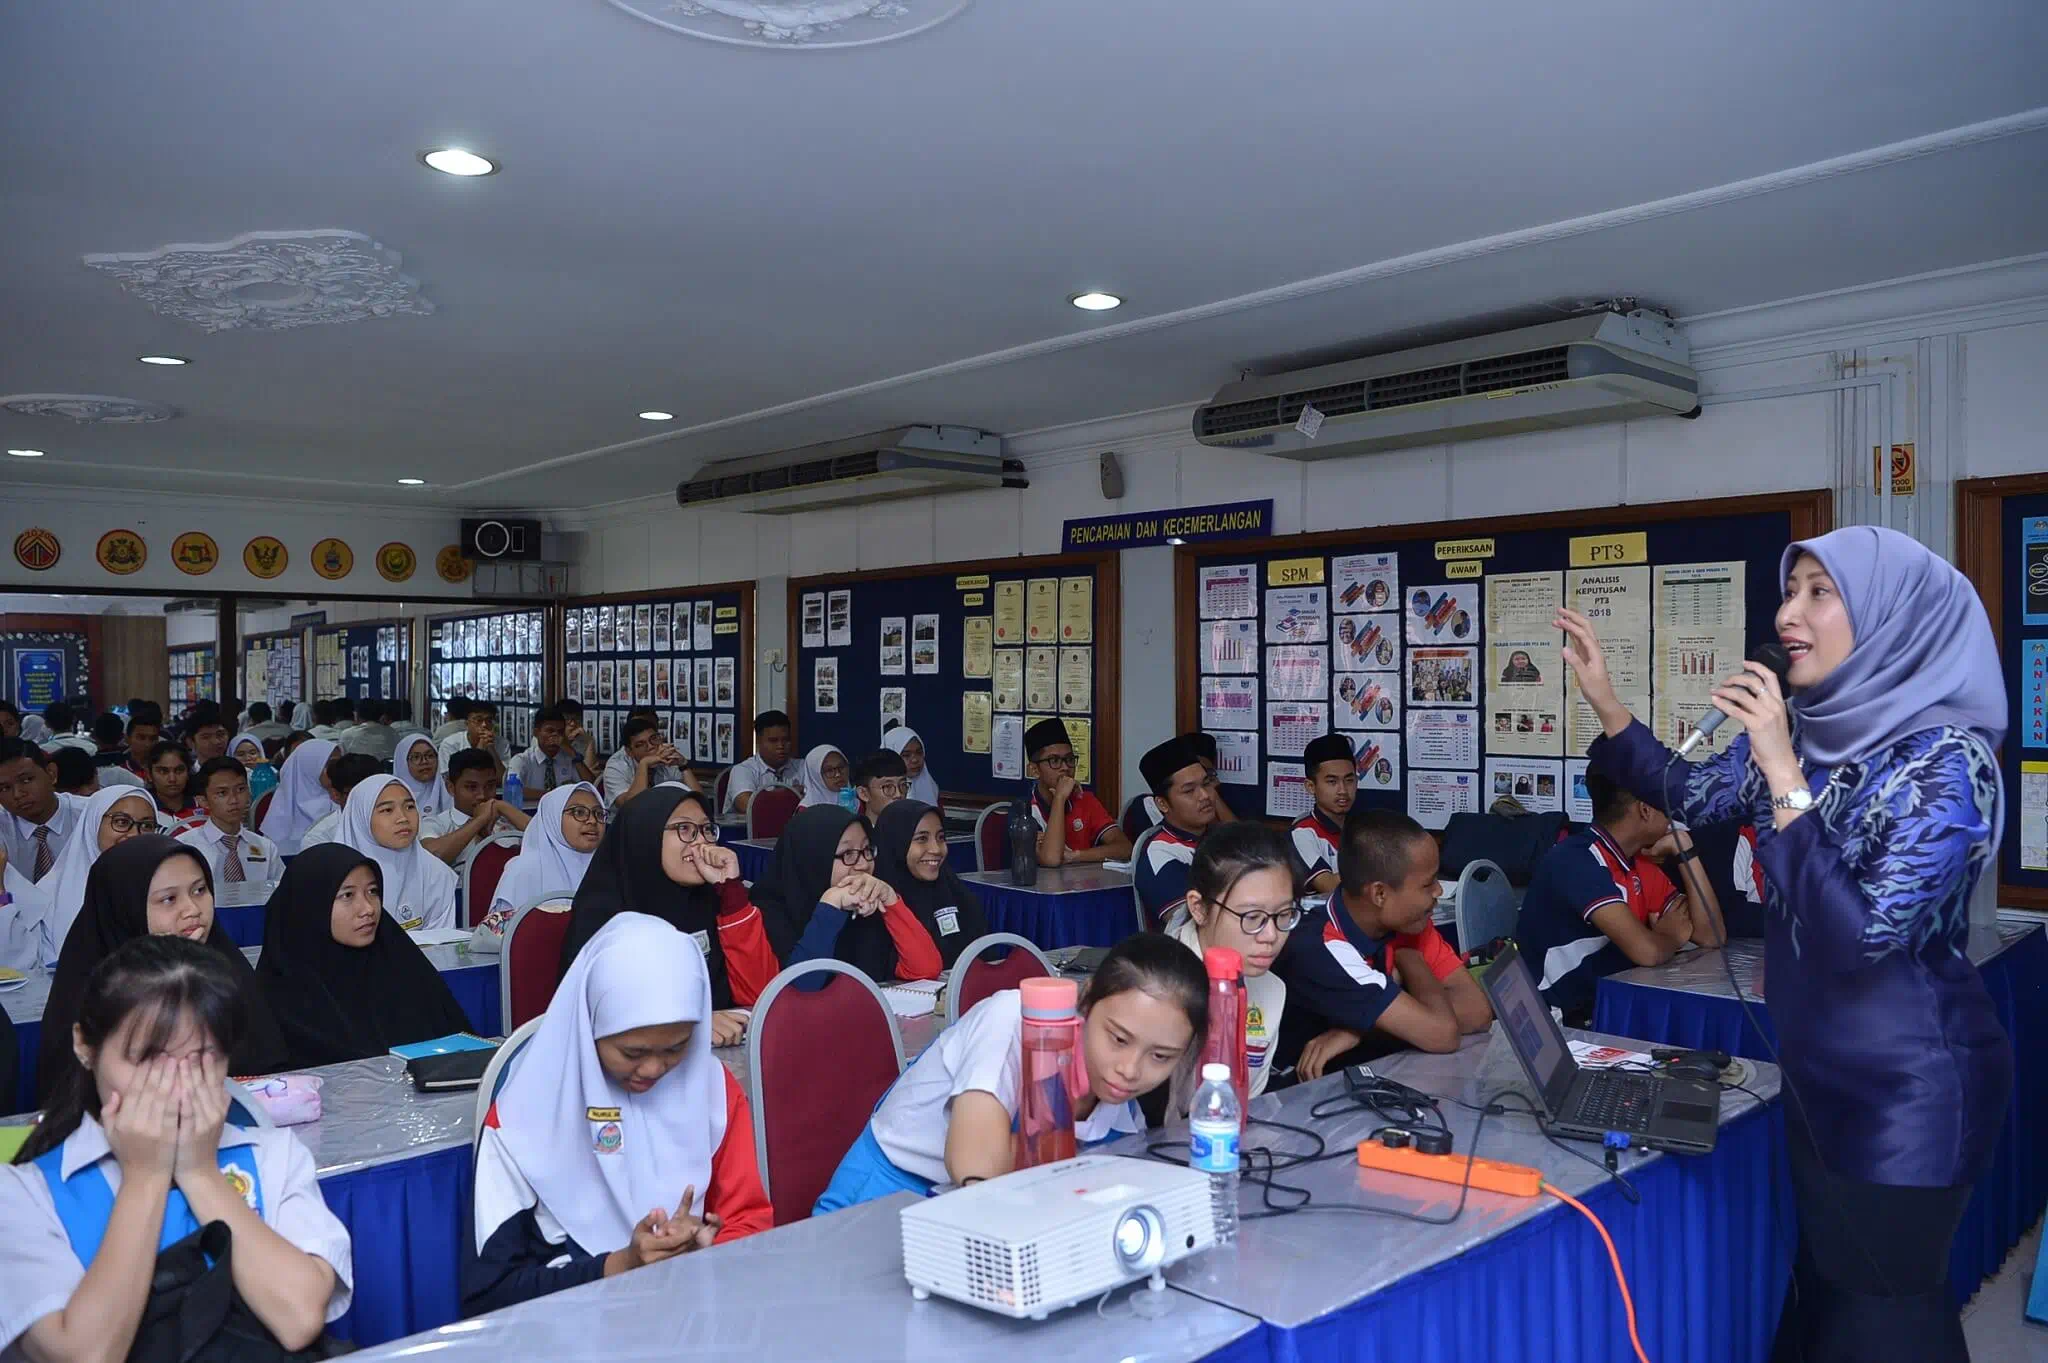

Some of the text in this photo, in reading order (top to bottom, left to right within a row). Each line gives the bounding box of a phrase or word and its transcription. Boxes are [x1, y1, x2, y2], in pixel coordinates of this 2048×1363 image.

[1070, 509, 1262, 544] PENCAPAIAN DAN KECEMERLANGAN
[1437, 544, 1492, 555] PEPERIKSAAN
[1591, 543, 1624, 561] PT3
[1281, 567, 1309, 582] SPM
[1450, 565, 1477, 574] AWAM
[1581, 576, 1620, 585] ANALISIS
[1575, 585, 1627, 595] KEPUTUSAN
[1594, 597, 1610, 605] PT3
[1588, 608, 1612, 617] 2018
[2033, 658, 2043, 741] ANJAKAN
